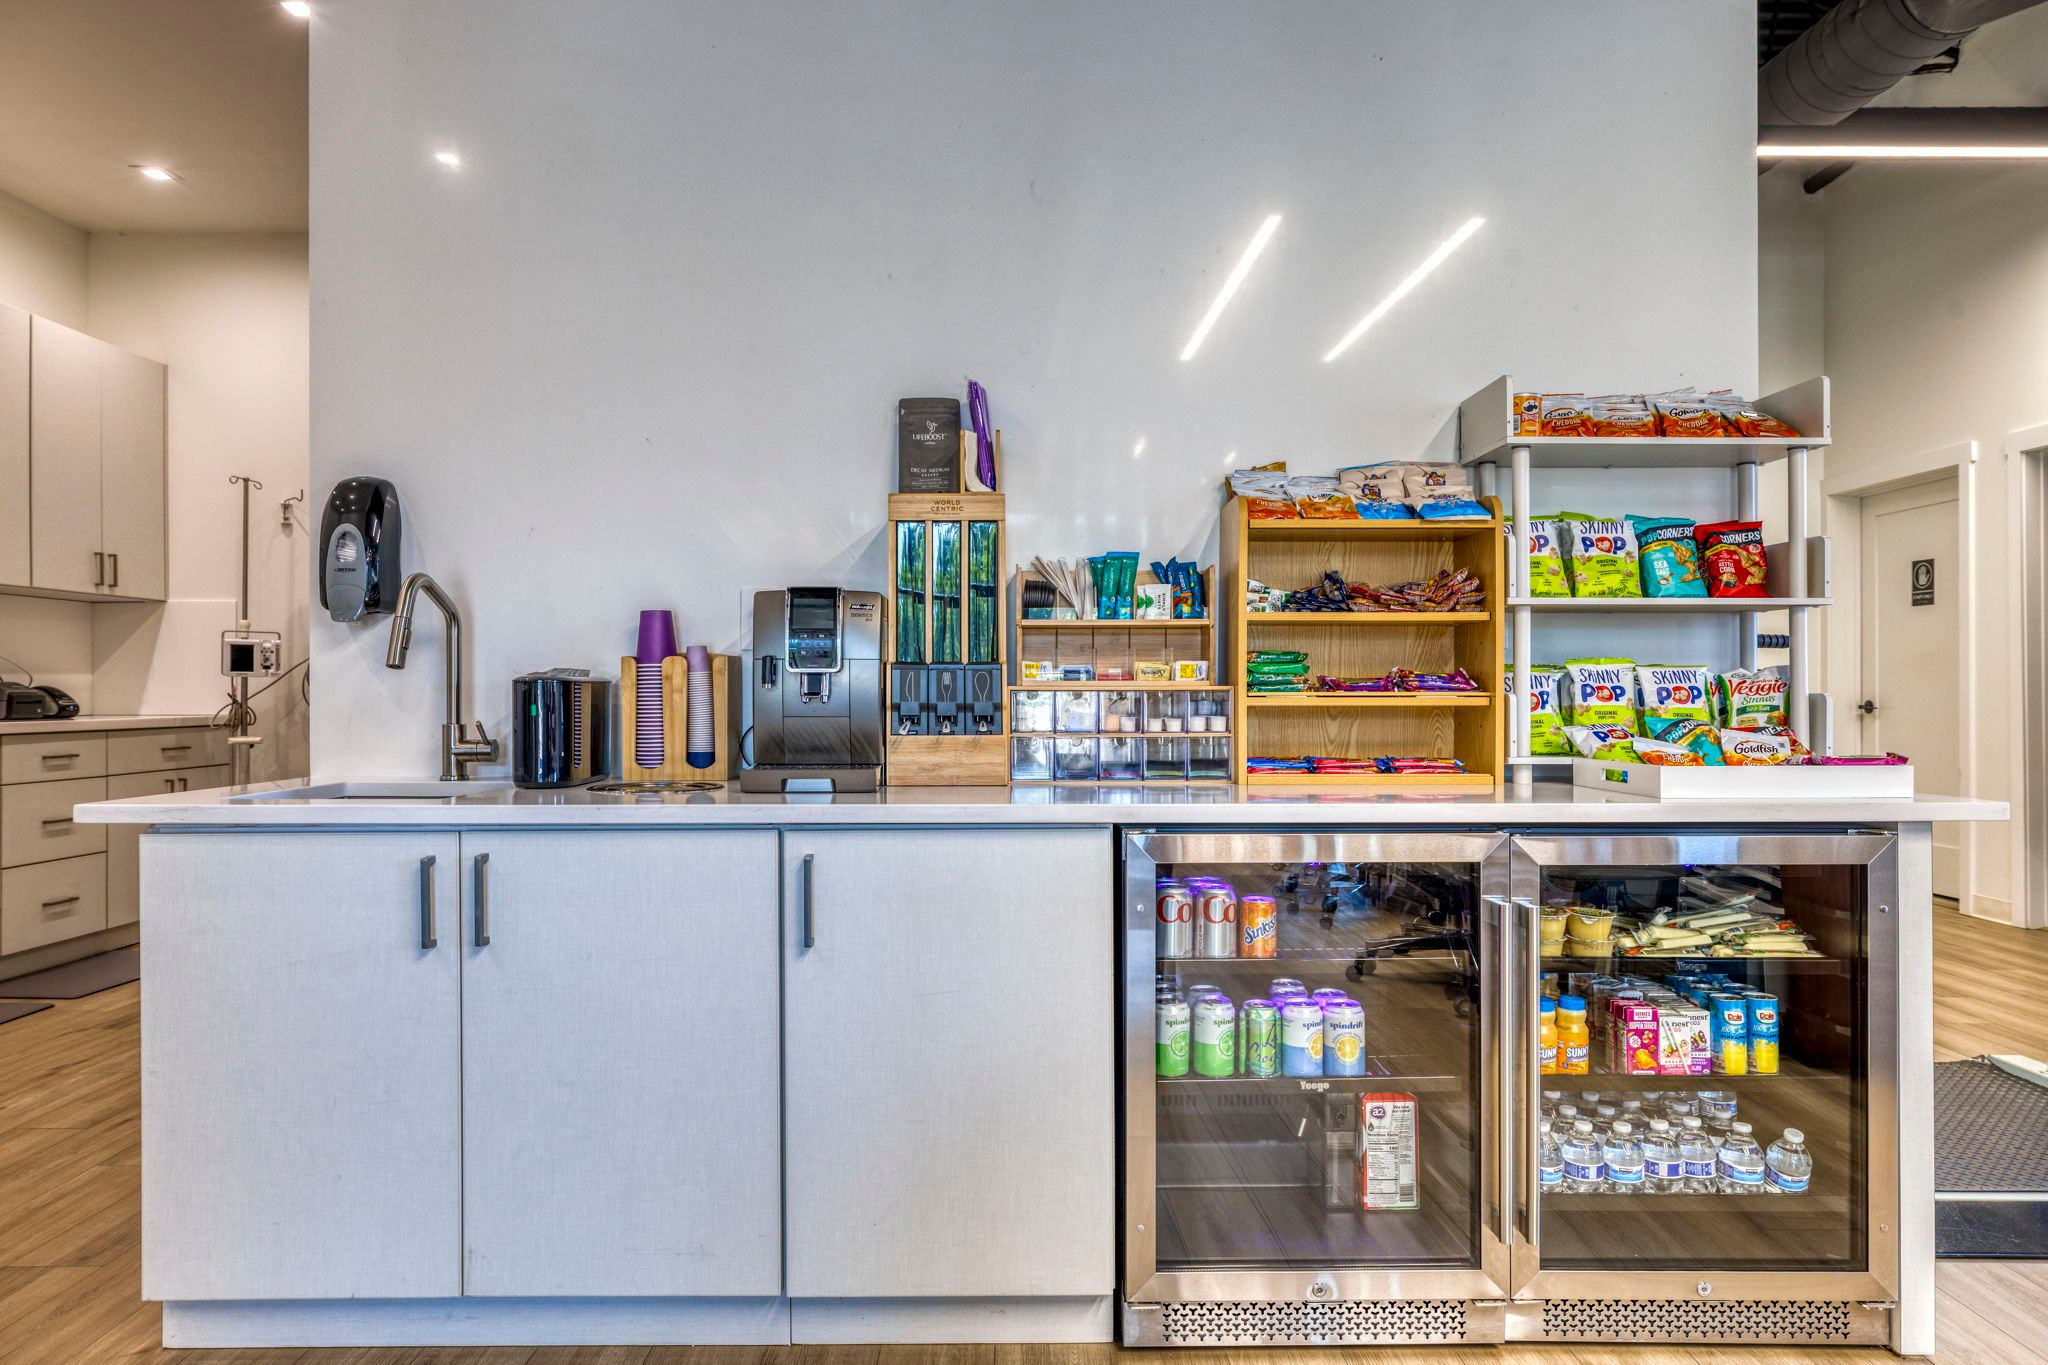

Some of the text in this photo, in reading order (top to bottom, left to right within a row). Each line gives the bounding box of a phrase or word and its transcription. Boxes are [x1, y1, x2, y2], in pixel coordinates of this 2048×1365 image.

[1581, 536, 1627, 555] POP
[1653, 560, 1669, 569] SEA
[1581, 683, 1627, 703] POP
[1728, 679, 1787, 698] Veggie
[1656, 685, 1703, 705] POP
[1741, 694, 1777, 706] Straws
[1734, 743, 1780, 755] Goldfish
[1727, 1013, 1742, 1021] Dole
[1759, 1012, 1774, 1020] Dole
[1329, 1020, 1363, 1031] spindrift
[1300, 1081, 1330, 1092] Yeego
[1372, 1108, 1386, 1117] a2
